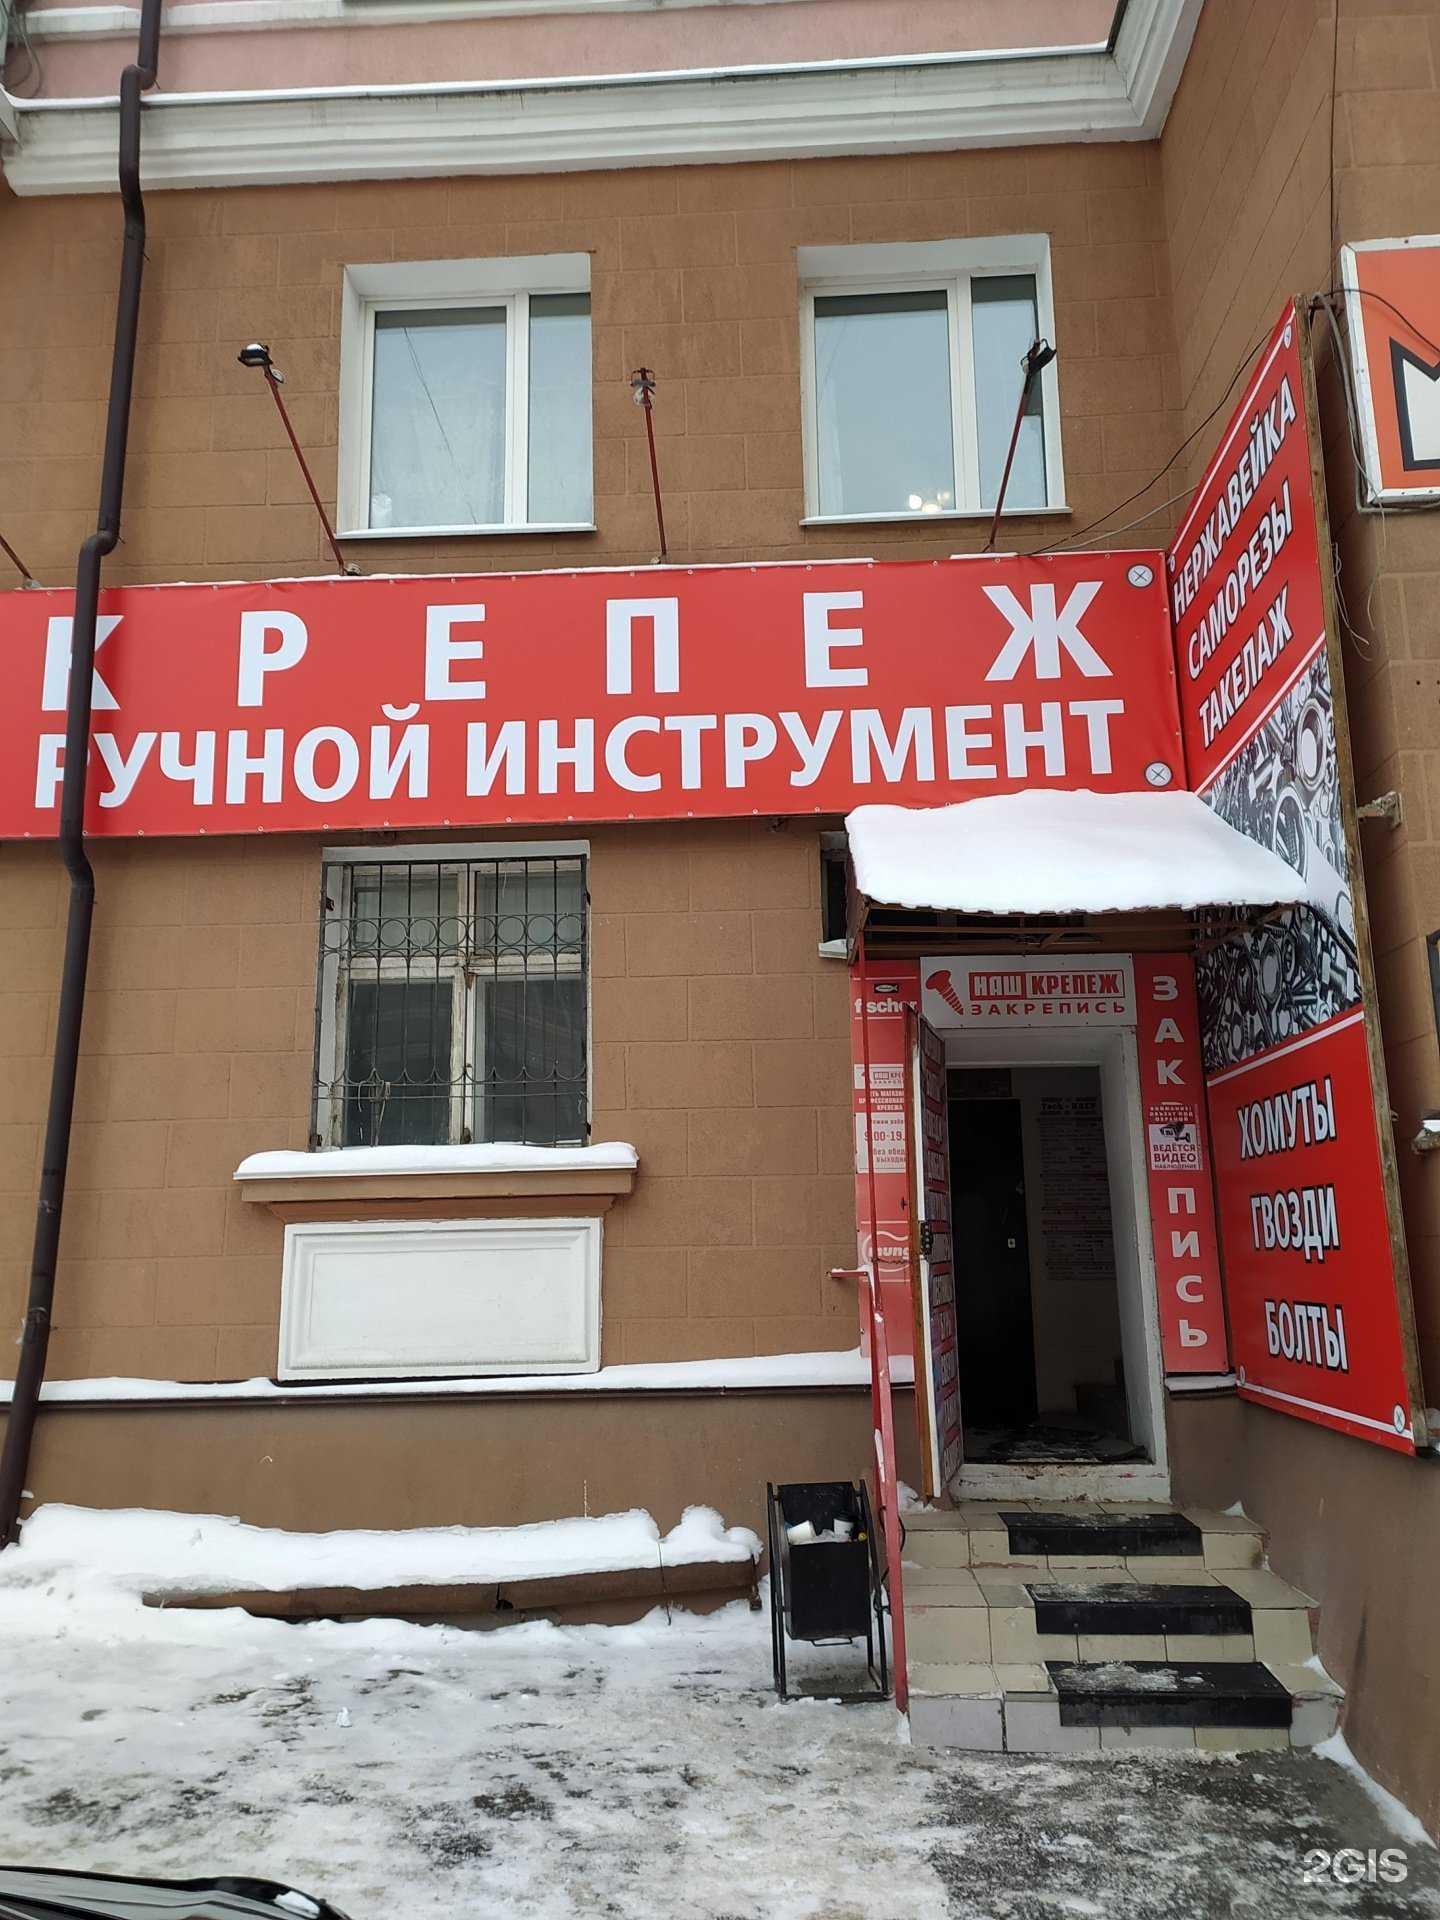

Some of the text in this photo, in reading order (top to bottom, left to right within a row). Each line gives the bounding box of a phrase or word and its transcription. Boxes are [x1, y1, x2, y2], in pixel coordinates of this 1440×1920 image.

[1174, 376, 1296, 625] НЕРЖАВЕЙКА
[1187, 480, 1294, 680] САМОРЕЗЫ
[41, 580, 1114, 711] КРЕПЕЖ
[1199, 586, 1295, 750] ТАКЕЛАЖ
[466, 699, 1125, 799] ИНСТРУМЕНТ
[971, 1001, 1127, 1017] ЗАКРЕПИСЬ
[973, 973, 1121, 997] НАШ КРЕПЕЖ
[1153, 1143, 1196, 1152] ВЕДЁТСЯ
[1153, 1153, 1197, 1164] ВИДЕО
[1237, 1075, 1337, 1161] ХОМУТЫ
[1152, 975, 1209, 1348] ЗАКПИСЬ
[1250, 1185, 1340, 1262] ГВОЗДИ
[1264, 1300, 1349, 1373] БОЛТЫ
